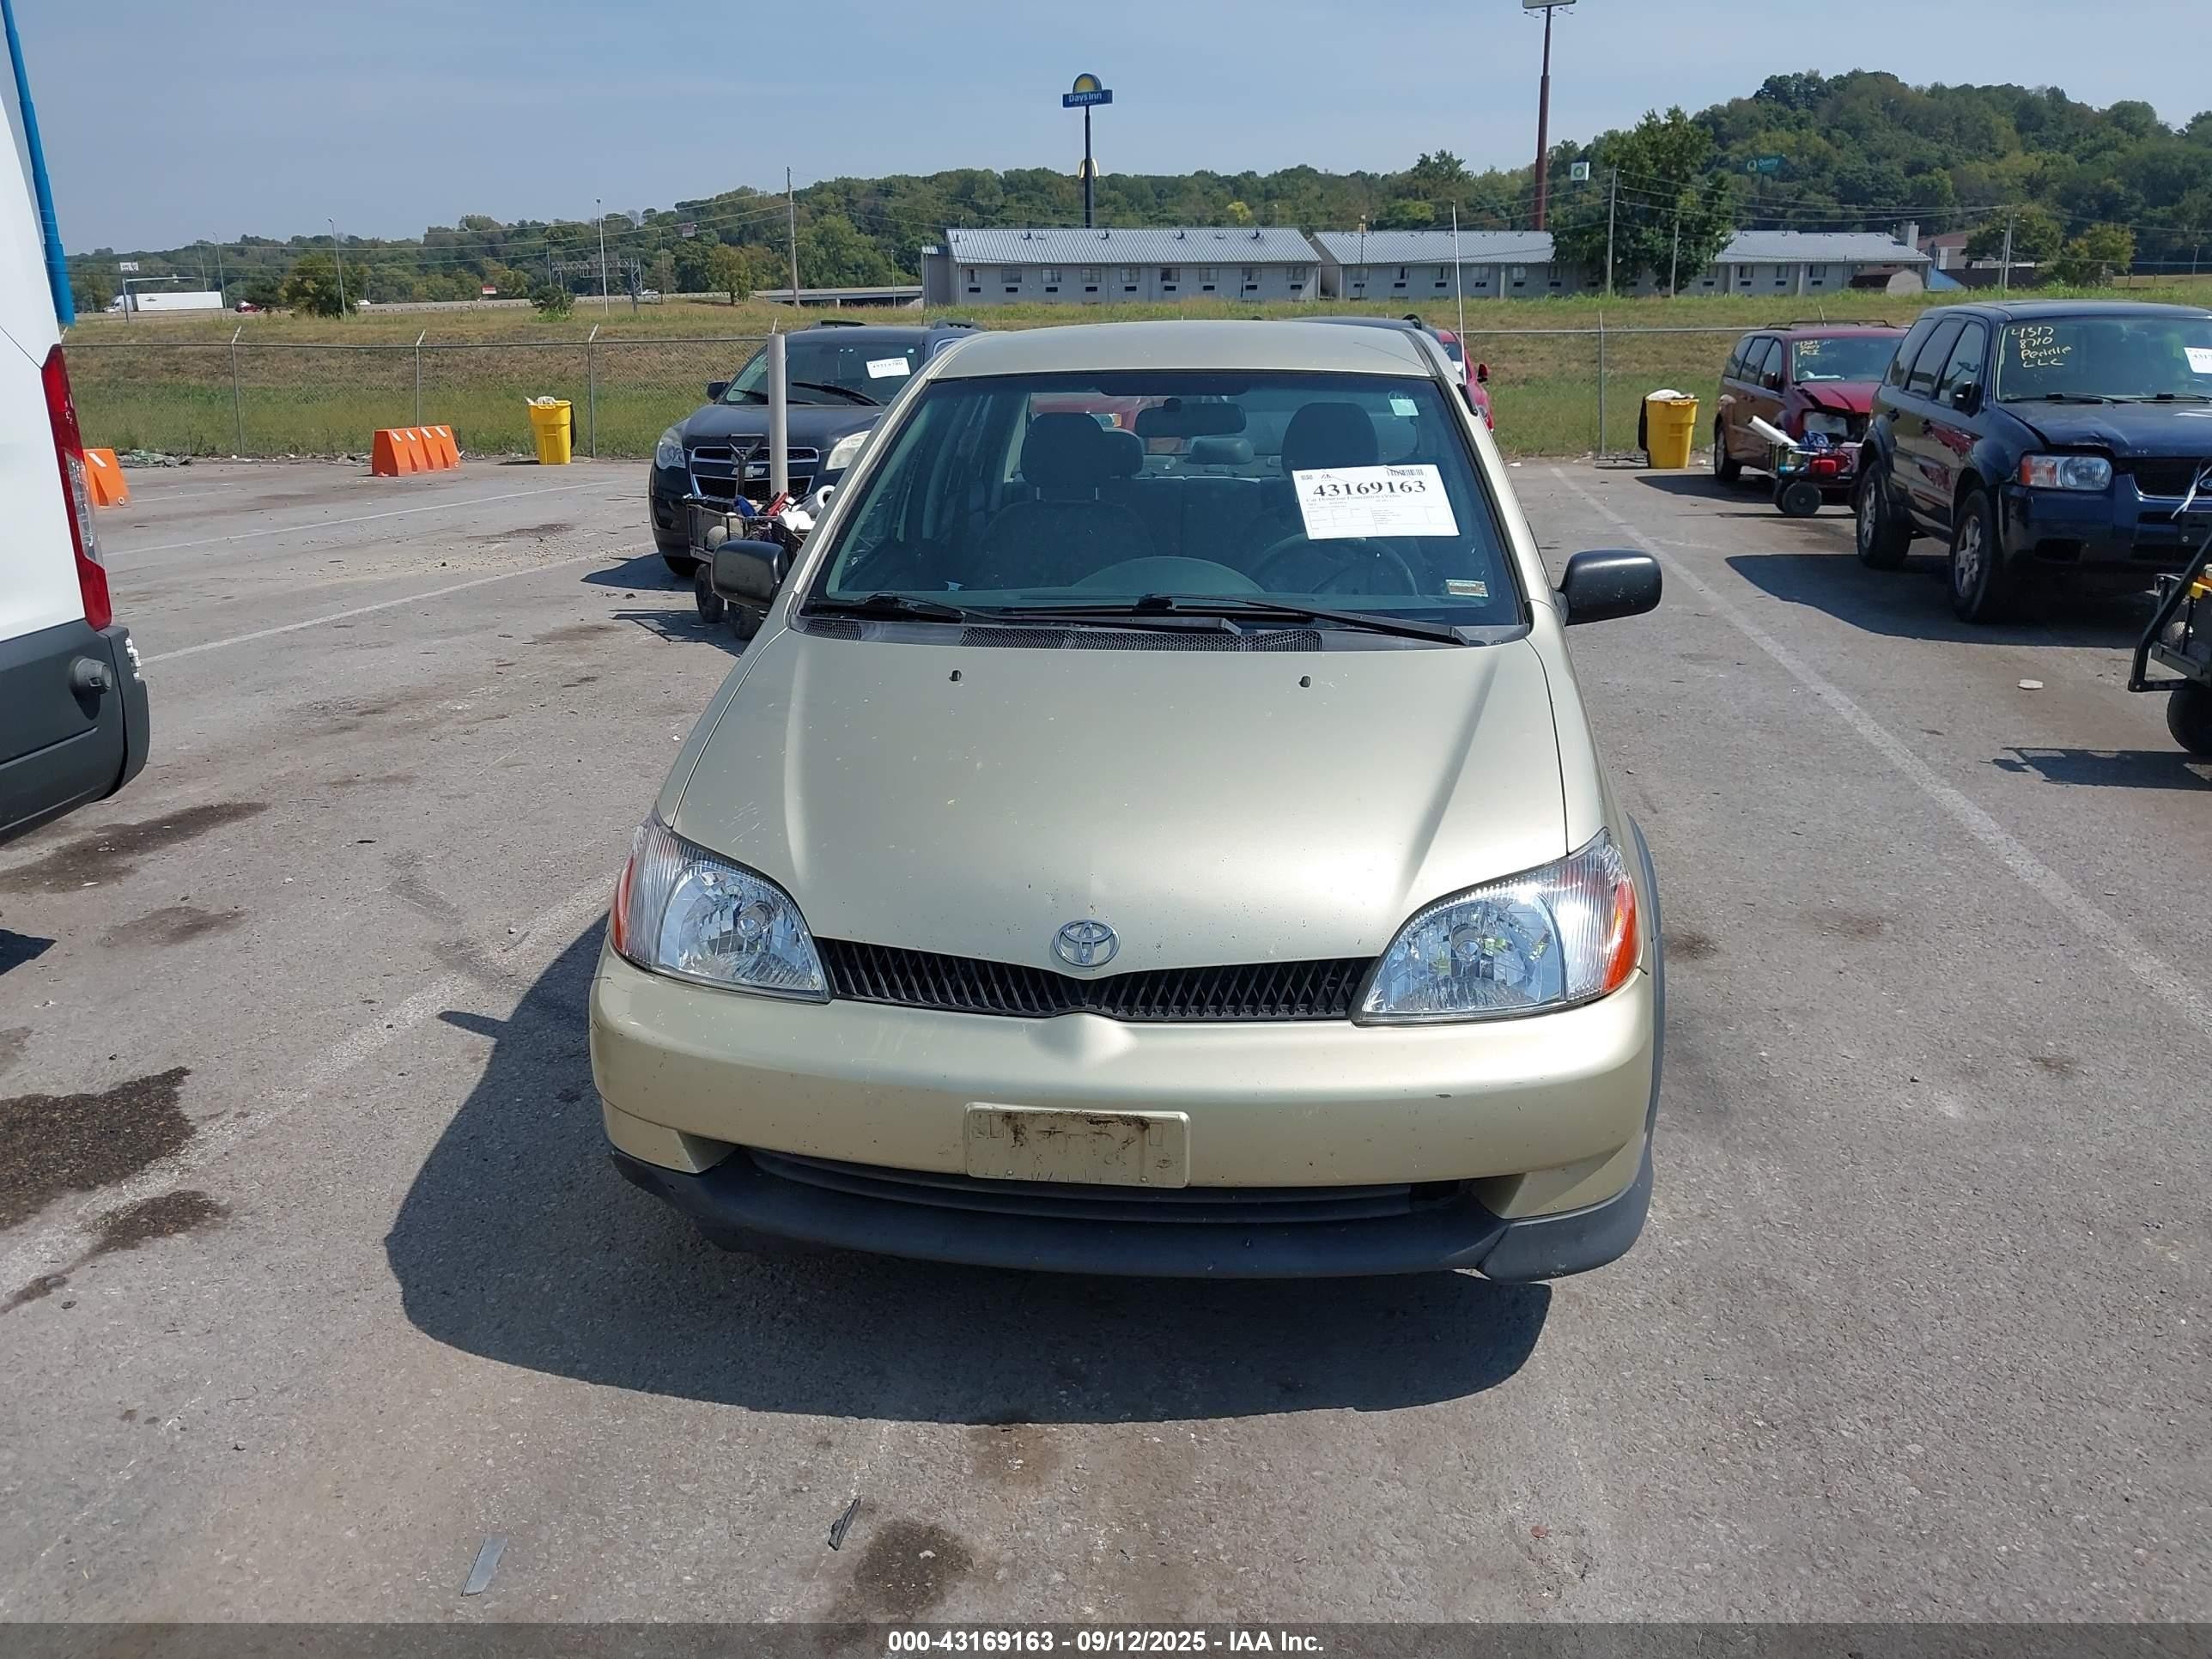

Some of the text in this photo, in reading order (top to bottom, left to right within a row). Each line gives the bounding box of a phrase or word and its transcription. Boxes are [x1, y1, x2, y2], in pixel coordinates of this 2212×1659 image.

[1069, 94, 1088, 103] Days
[1089, 92, 1103, 101] Inn
[2019, 336, 2053, 349] 8710
[2022, 358, 2065, 368] LLC
[1313, 480, 1426, 497] 43169163
